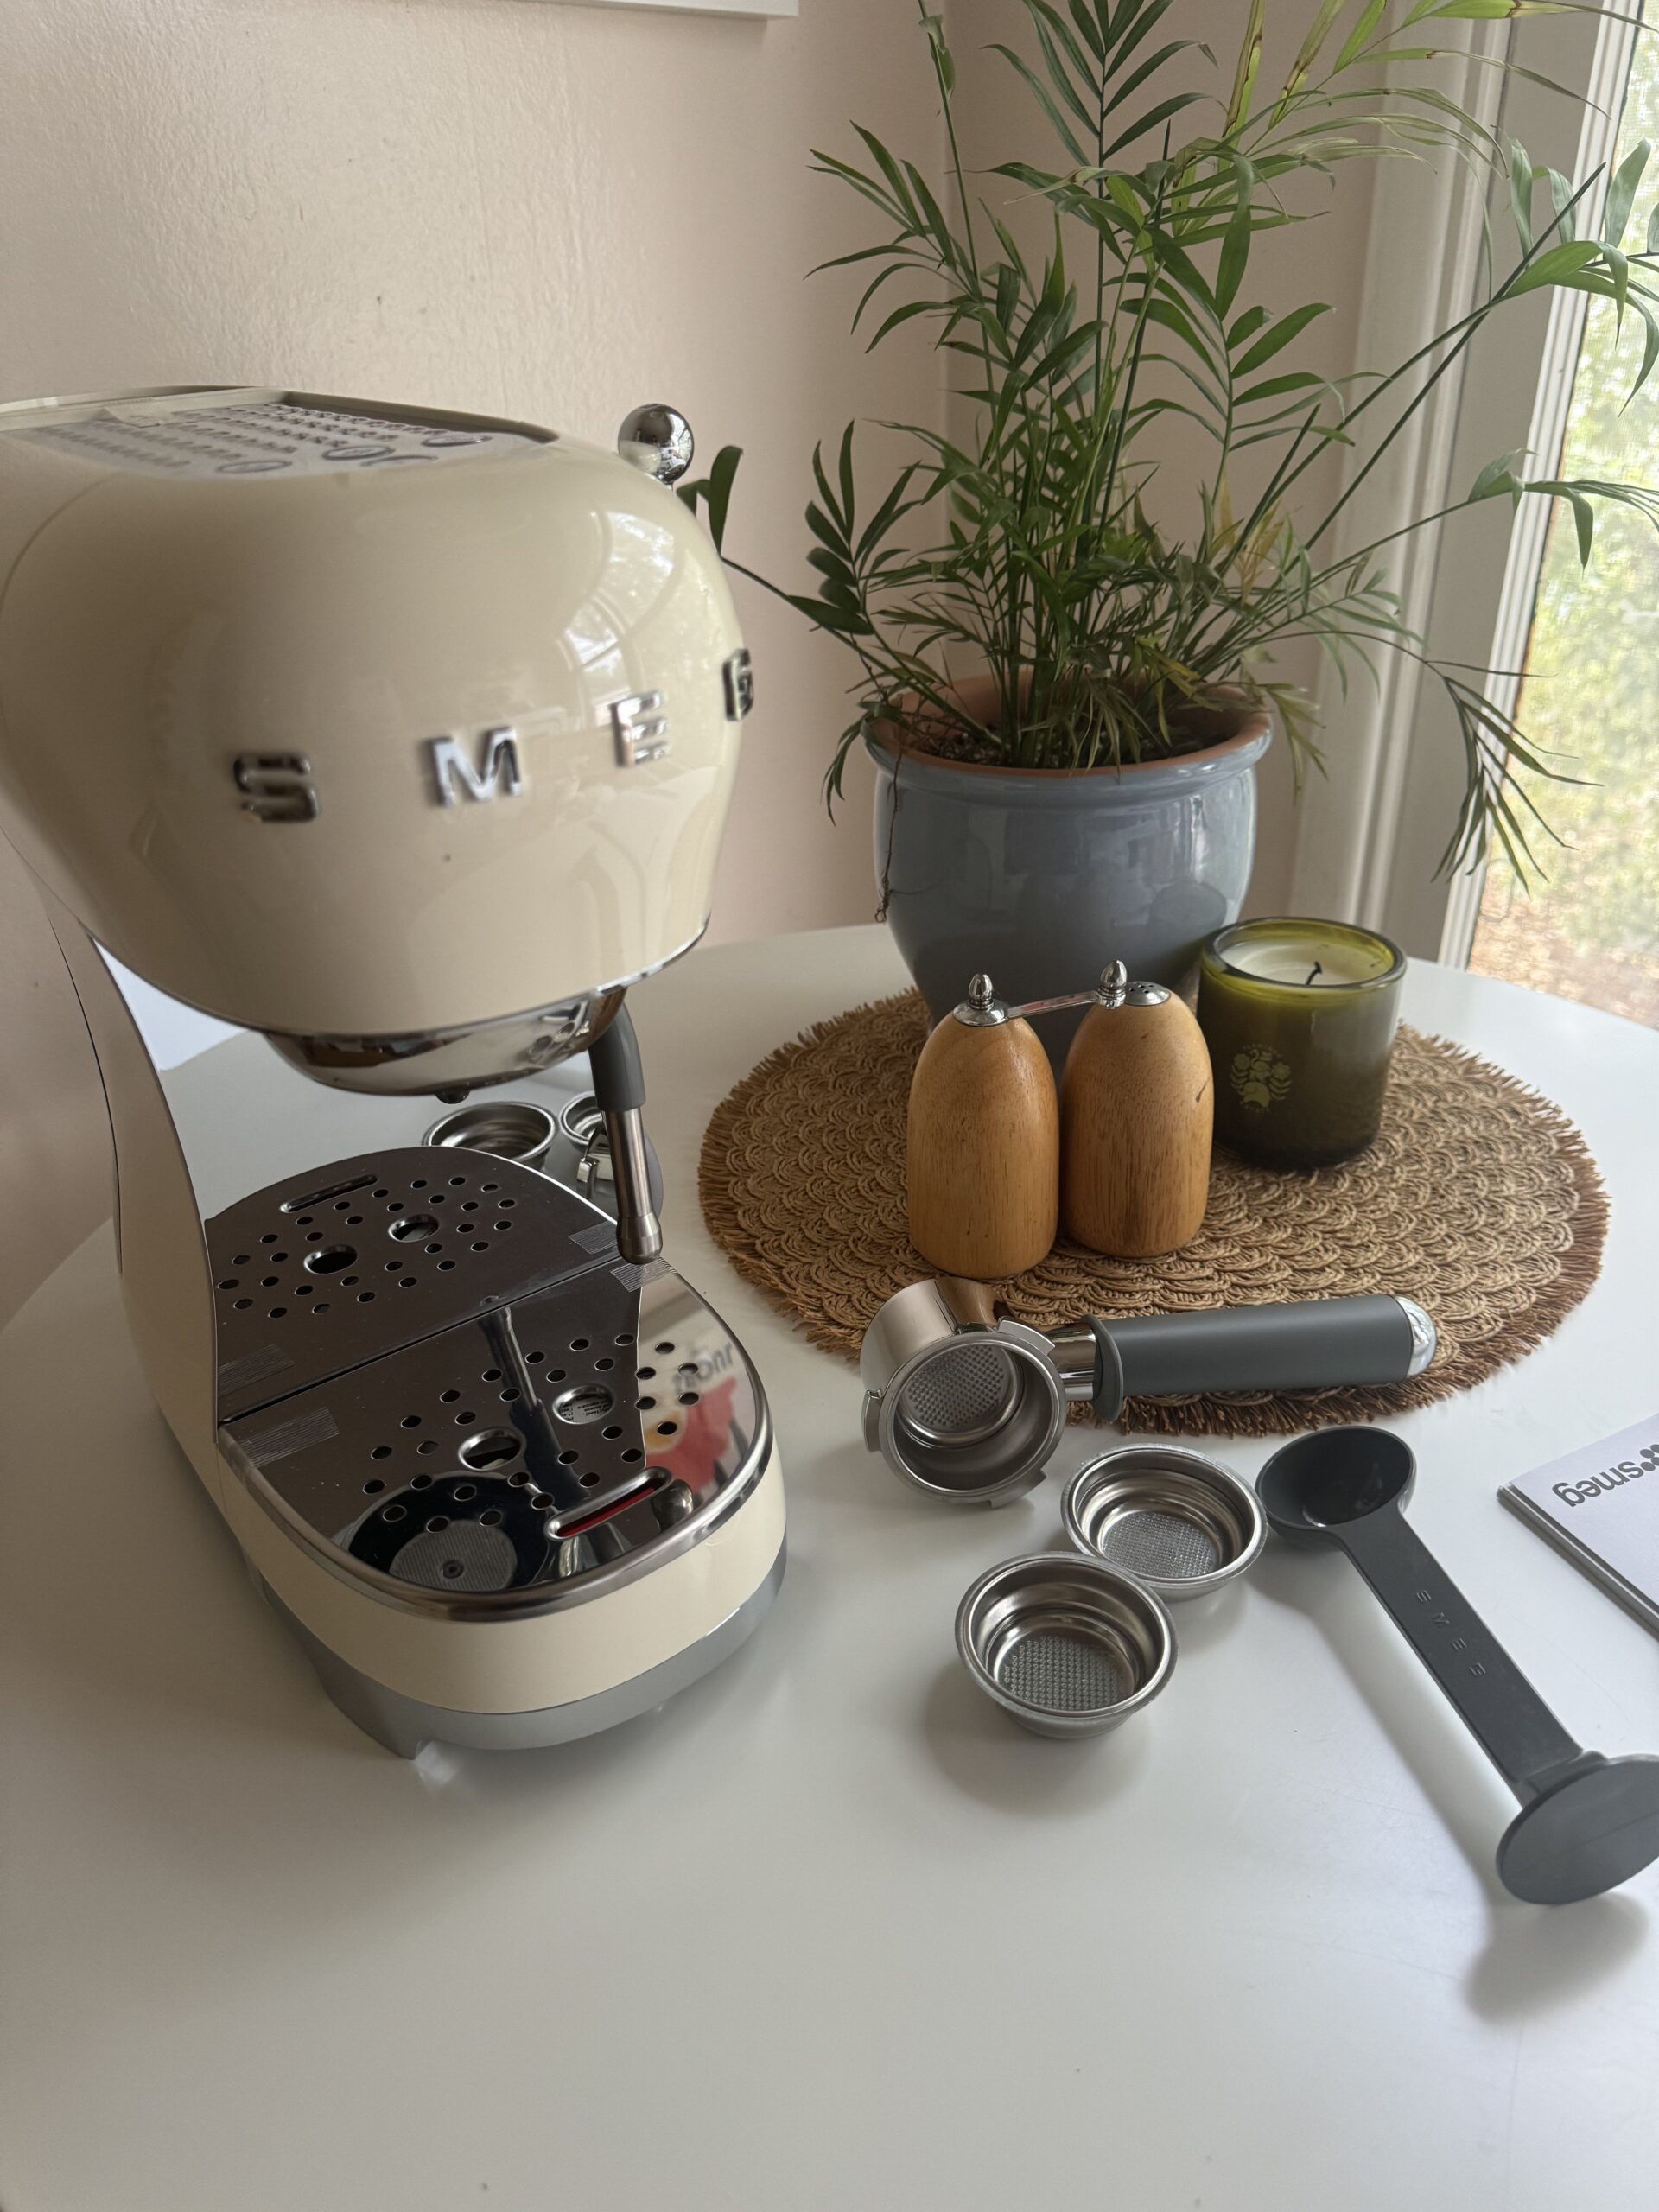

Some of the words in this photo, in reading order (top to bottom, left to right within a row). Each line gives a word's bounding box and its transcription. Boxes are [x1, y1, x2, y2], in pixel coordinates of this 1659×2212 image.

[232, 648, 753, 823] SMEG
[1552, 1461, 1644, 1508] smeg
[1416, 1590, 1486, 1676] SMEG
